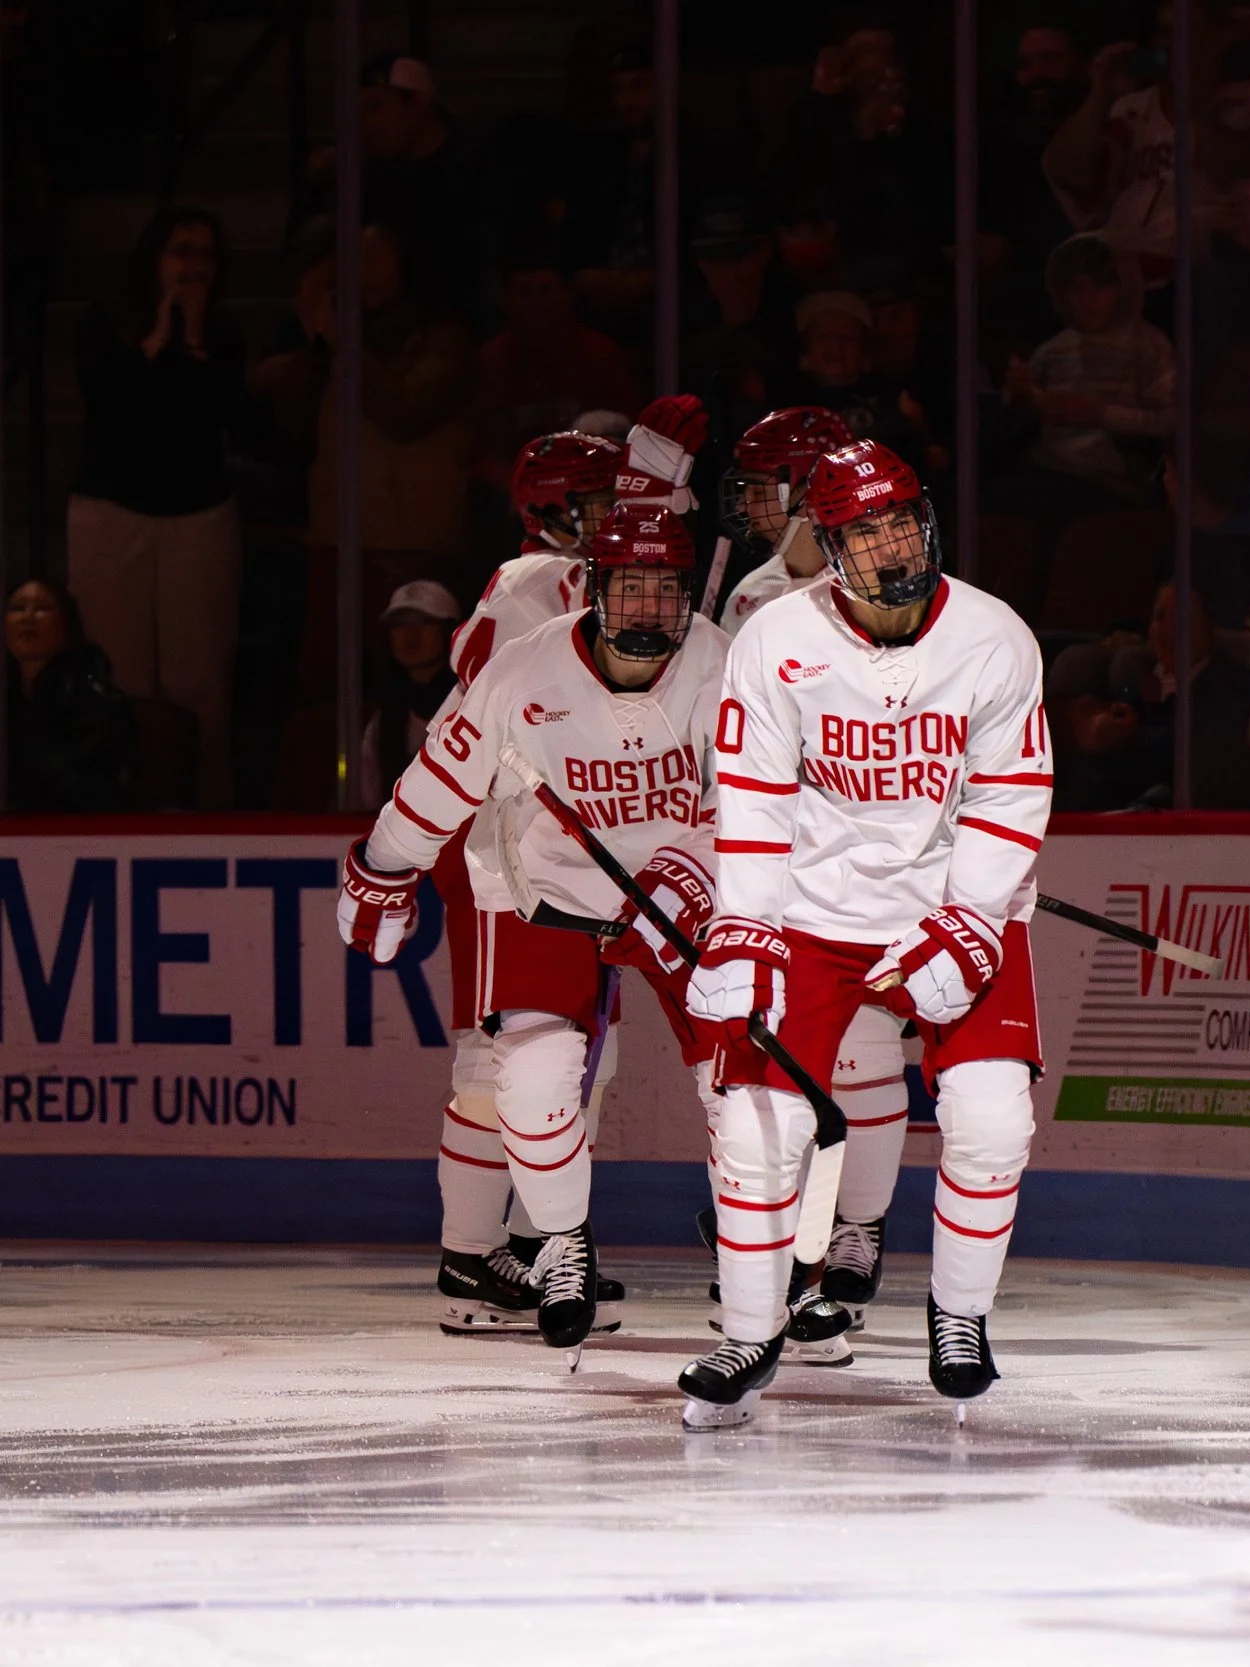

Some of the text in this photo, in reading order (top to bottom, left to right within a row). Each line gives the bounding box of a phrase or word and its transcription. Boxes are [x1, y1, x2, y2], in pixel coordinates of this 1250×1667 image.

[854, 461, 876, 478] 10
[856, 480, 894, 502] BOSTON
[638, 521, 660, 534] 25
[633, 543, 666, 554] BOSTON
[822, 712, 968, 761] BOSTON
[3, 1075, 297, 1126] REDIT UNION
